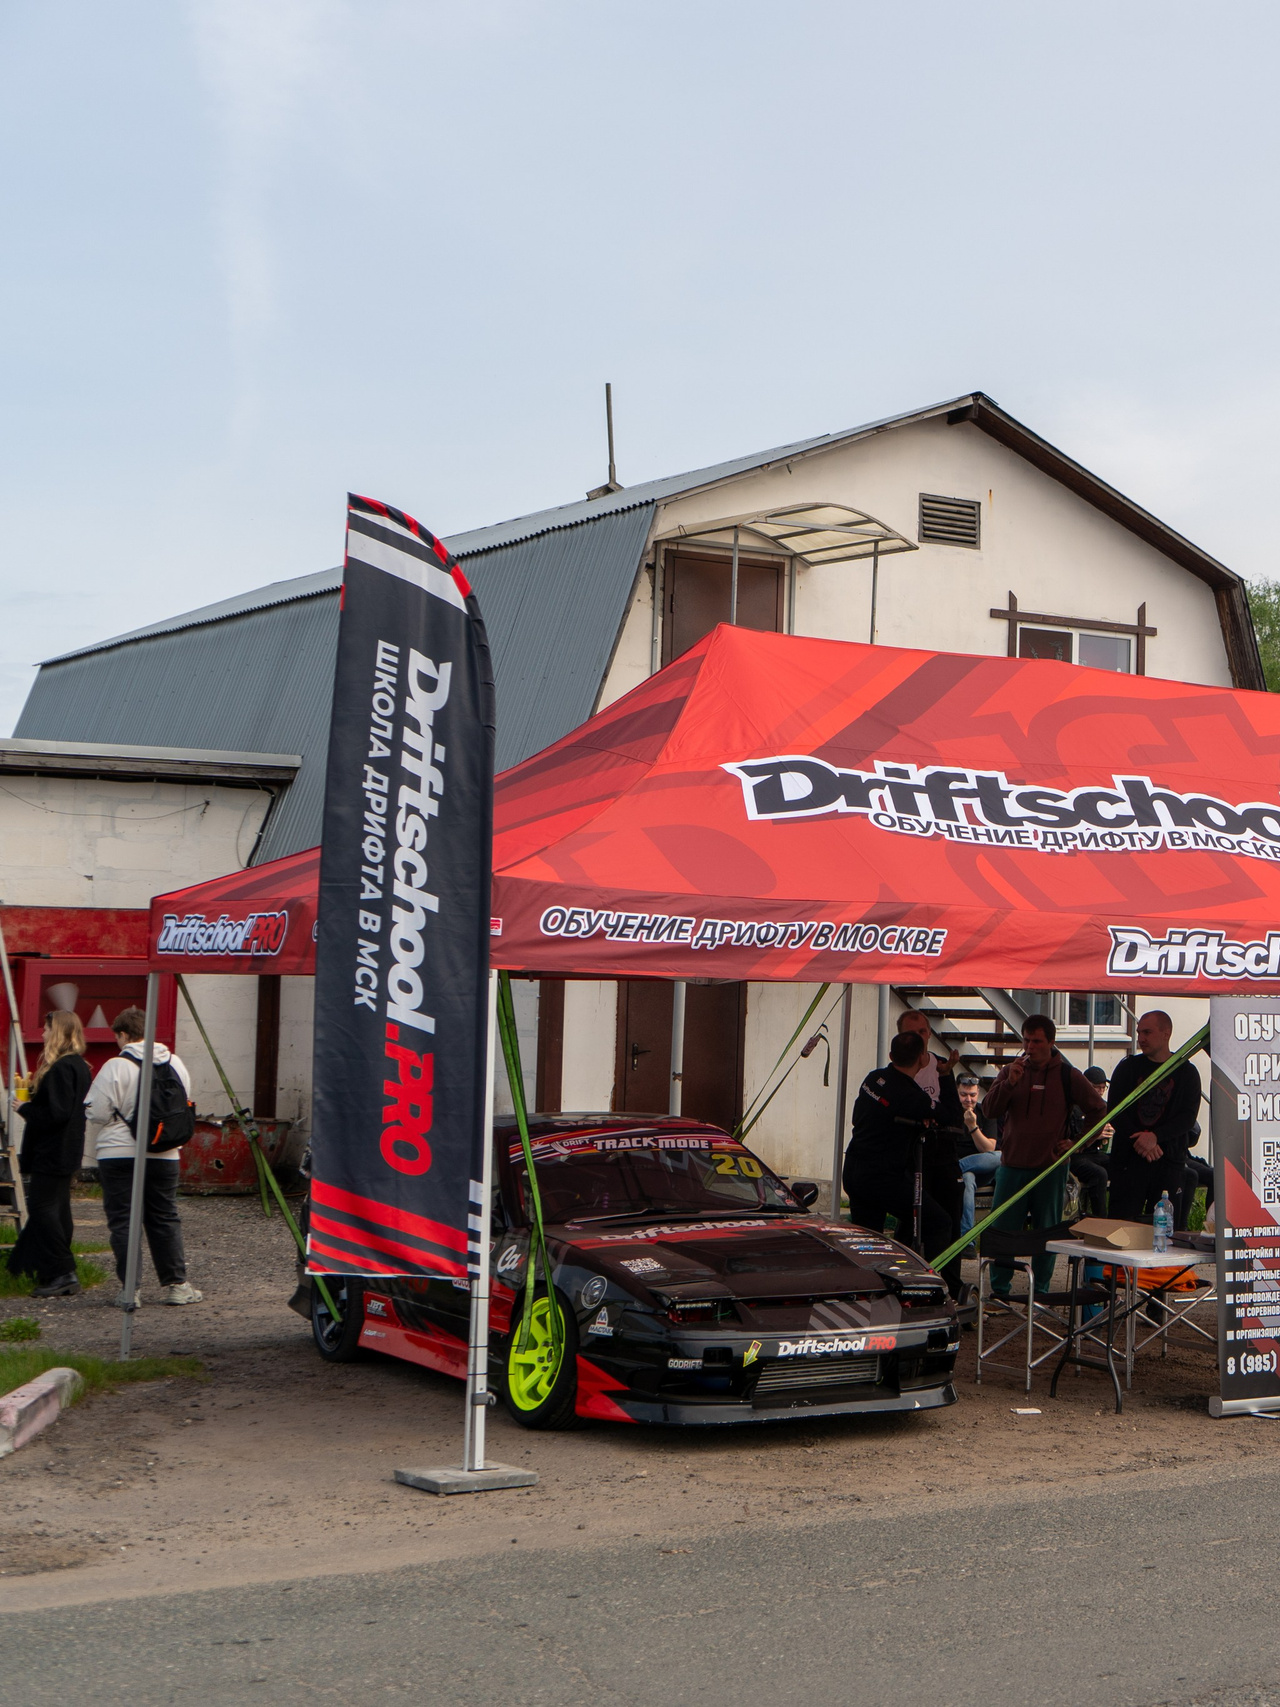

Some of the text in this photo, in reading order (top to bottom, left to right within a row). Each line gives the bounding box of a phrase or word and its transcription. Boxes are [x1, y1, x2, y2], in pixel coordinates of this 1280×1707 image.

[354, 640, 400, 1013] ШКОЛА ДРИФТА В МСК
[871, 810, 1034, 849] ОБУЧЕНИЕ
[1038, 828, 1161, 855] ДРИФТУ
[1167, 832, 1187, 849] В
[379, 647, 453, 1177] Driftschool.PRO
[157, 911, 288, 956] Driftschool.PRO
[540, 906, 947, 956] ОБУЧЕНИЕ ДРИФТУ В МОСКВЕ
[1237, 1093, 1251, 1121] В
[563, 1137, 709, 1150] DRIFT TRACK MODE
[710, 1153, 764, 1179] 20
[1234, 1228, 1252, 1238] 100%
[1235, 1246, 1274, 1260] ПОСТРОЙКА
[1275, 1247, 1280, 1258] И
[1235, 1269, 1280, 1282] ПОДАРОЧНЫЕ
[1235, 1306, 1245, 1318] НА
[777, 1336, 897, 1357] Driftschool.PRO
[1227, 1356, 1236, 1375] 8
[1240, 1350, 1277, 1375] (985)
